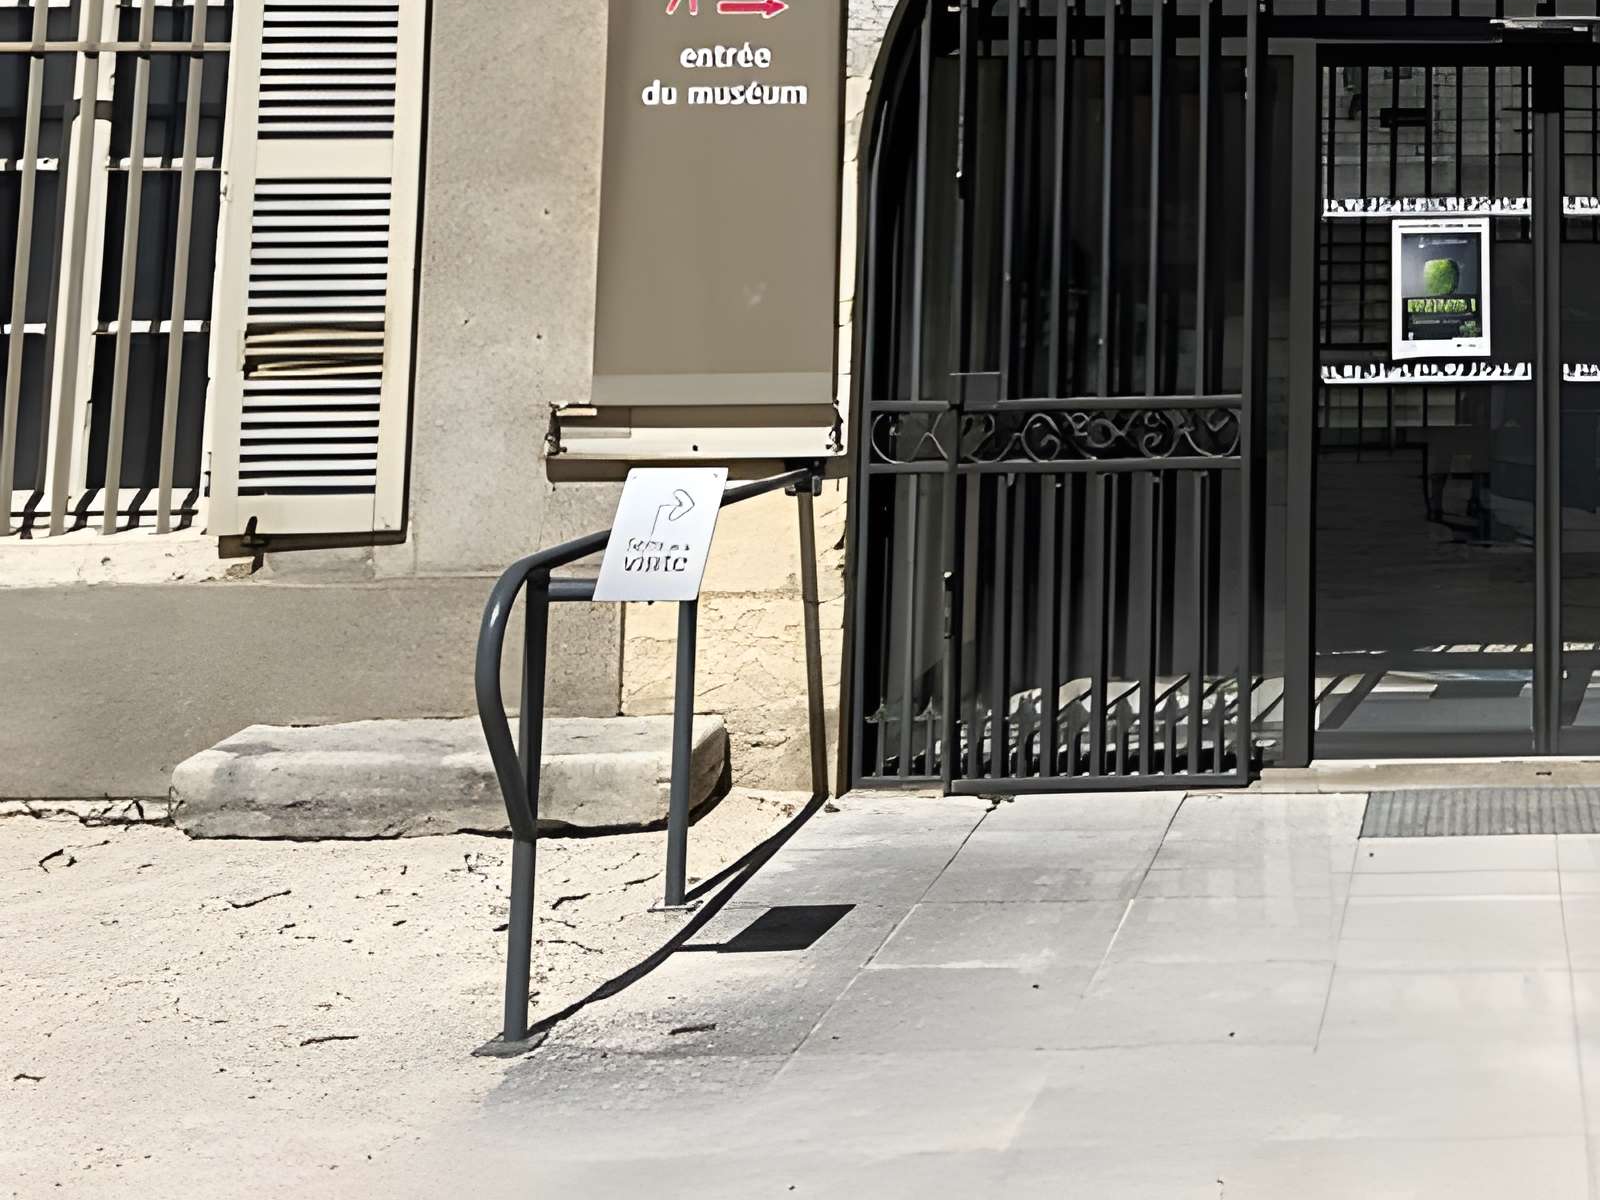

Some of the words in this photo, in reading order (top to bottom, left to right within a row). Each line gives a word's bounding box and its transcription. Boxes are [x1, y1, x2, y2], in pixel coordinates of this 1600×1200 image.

[679, 41, 772, 69] entrée
[641, 78, 678, 106] du
[687, 80, 809, 106] muséum
